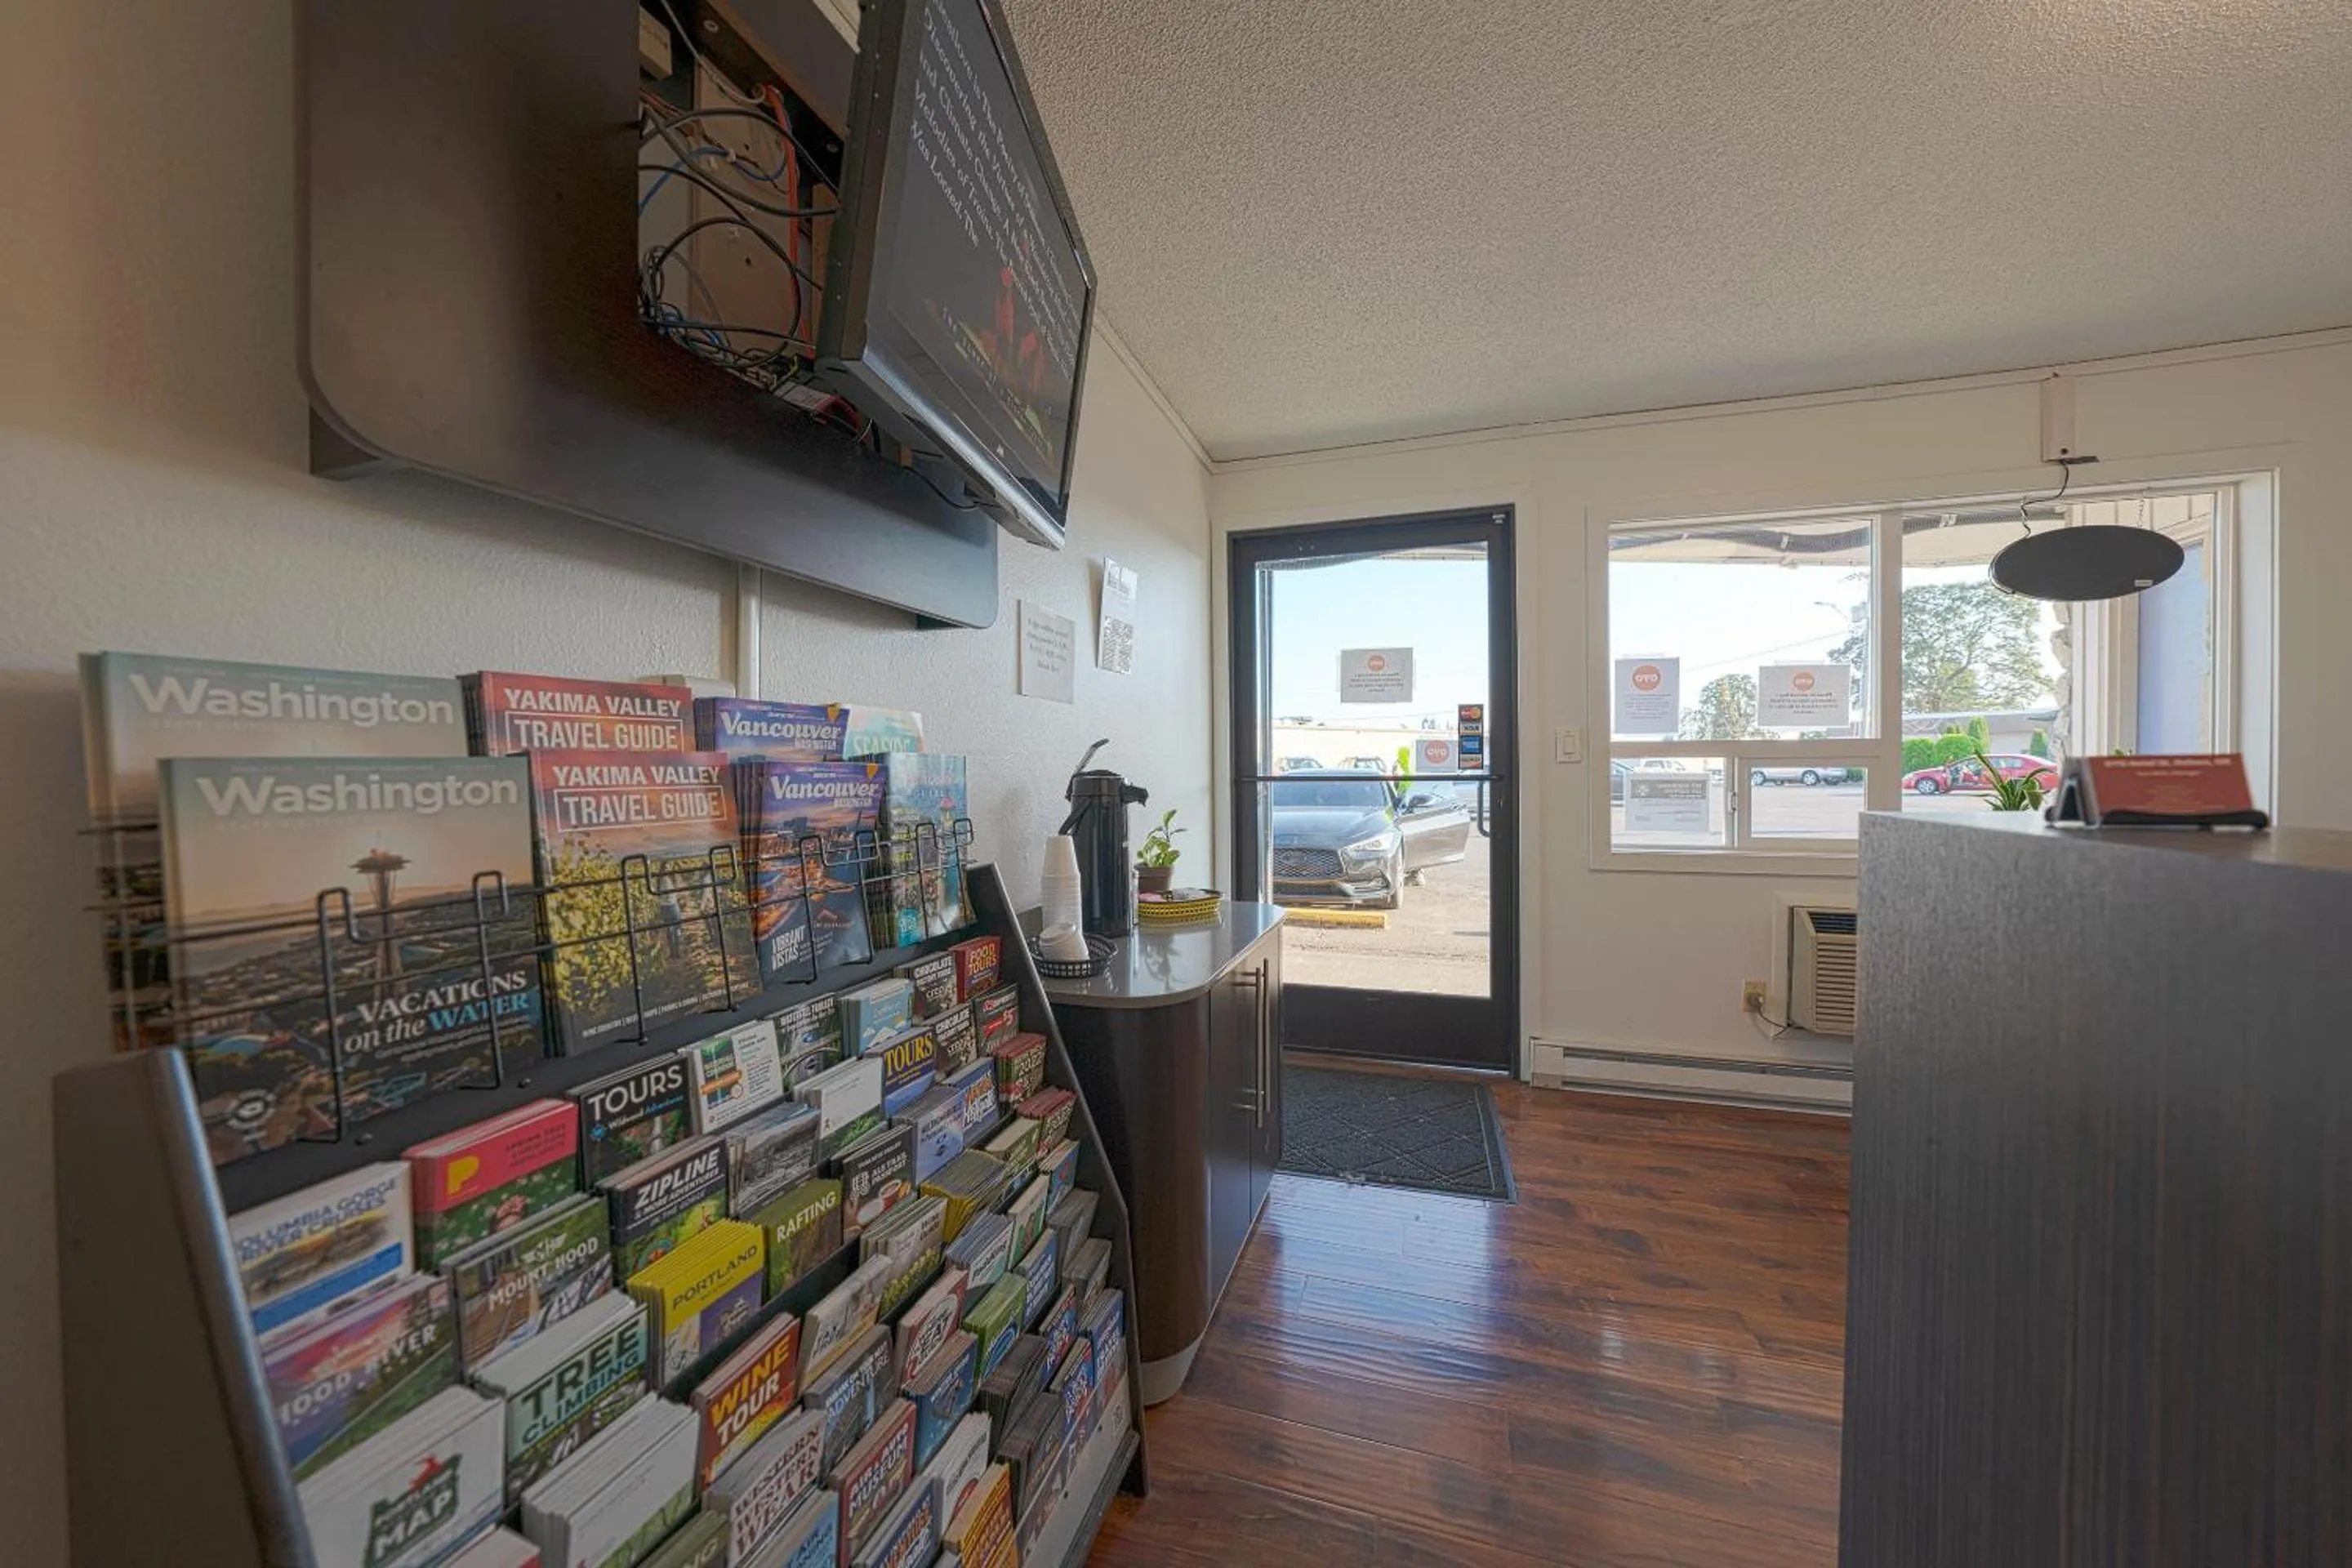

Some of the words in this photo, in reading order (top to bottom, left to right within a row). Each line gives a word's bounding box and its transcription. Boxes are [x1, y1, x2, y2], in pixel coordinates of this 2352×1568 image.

[129, 674, 454, 728] Washington
[505, 688, 601, 714] YAKIMA
[605, 695, 681, 718] VALLEY
[719, 711, 841, 739] Vancouver
[514, 719, 609, 749] TRAVEL
[615, 723, 678, 750] GUIDE
[196, 774, 517, 814] Washington
[552, 764, 646, 786] YAKIMA
[651, 764, 720, 785] VALLEY
[771, 776, 879, 800] Vancouver
[563, 794, 657, 825] TRAVEL
[661, 791, 719, 817] GUIDE
[969, 956, 996, 974] TOURS
[970, 943, 995, 959] FOOD
[345, 1029, 381, 1054] on
[385, 1016, 427, 1045] the
[884, 1032, 933, 1076] TOURS
[587, 1064, 683, 1121] TOURS
[635, 1147, 719, 1209] ZIPLINE
[777, 1192, 836, 1244] RAFTING
[488, 1265, 547, 1312] MOUNT
[555, 1237, 598, 1268] HOOD
[672, 1245, 757, 1310] PORTLAND
[521, 1319, 640, 1422] TREE
[710, 1337, 791, 1425] WINE
[522, 1350, 639, 1446] CLIMBING
[717, 1371, 780, 1446] TOUR
[850, 1434, 908, 1517] MUSEUM
[376, 1490, 451, 1560] MAP
